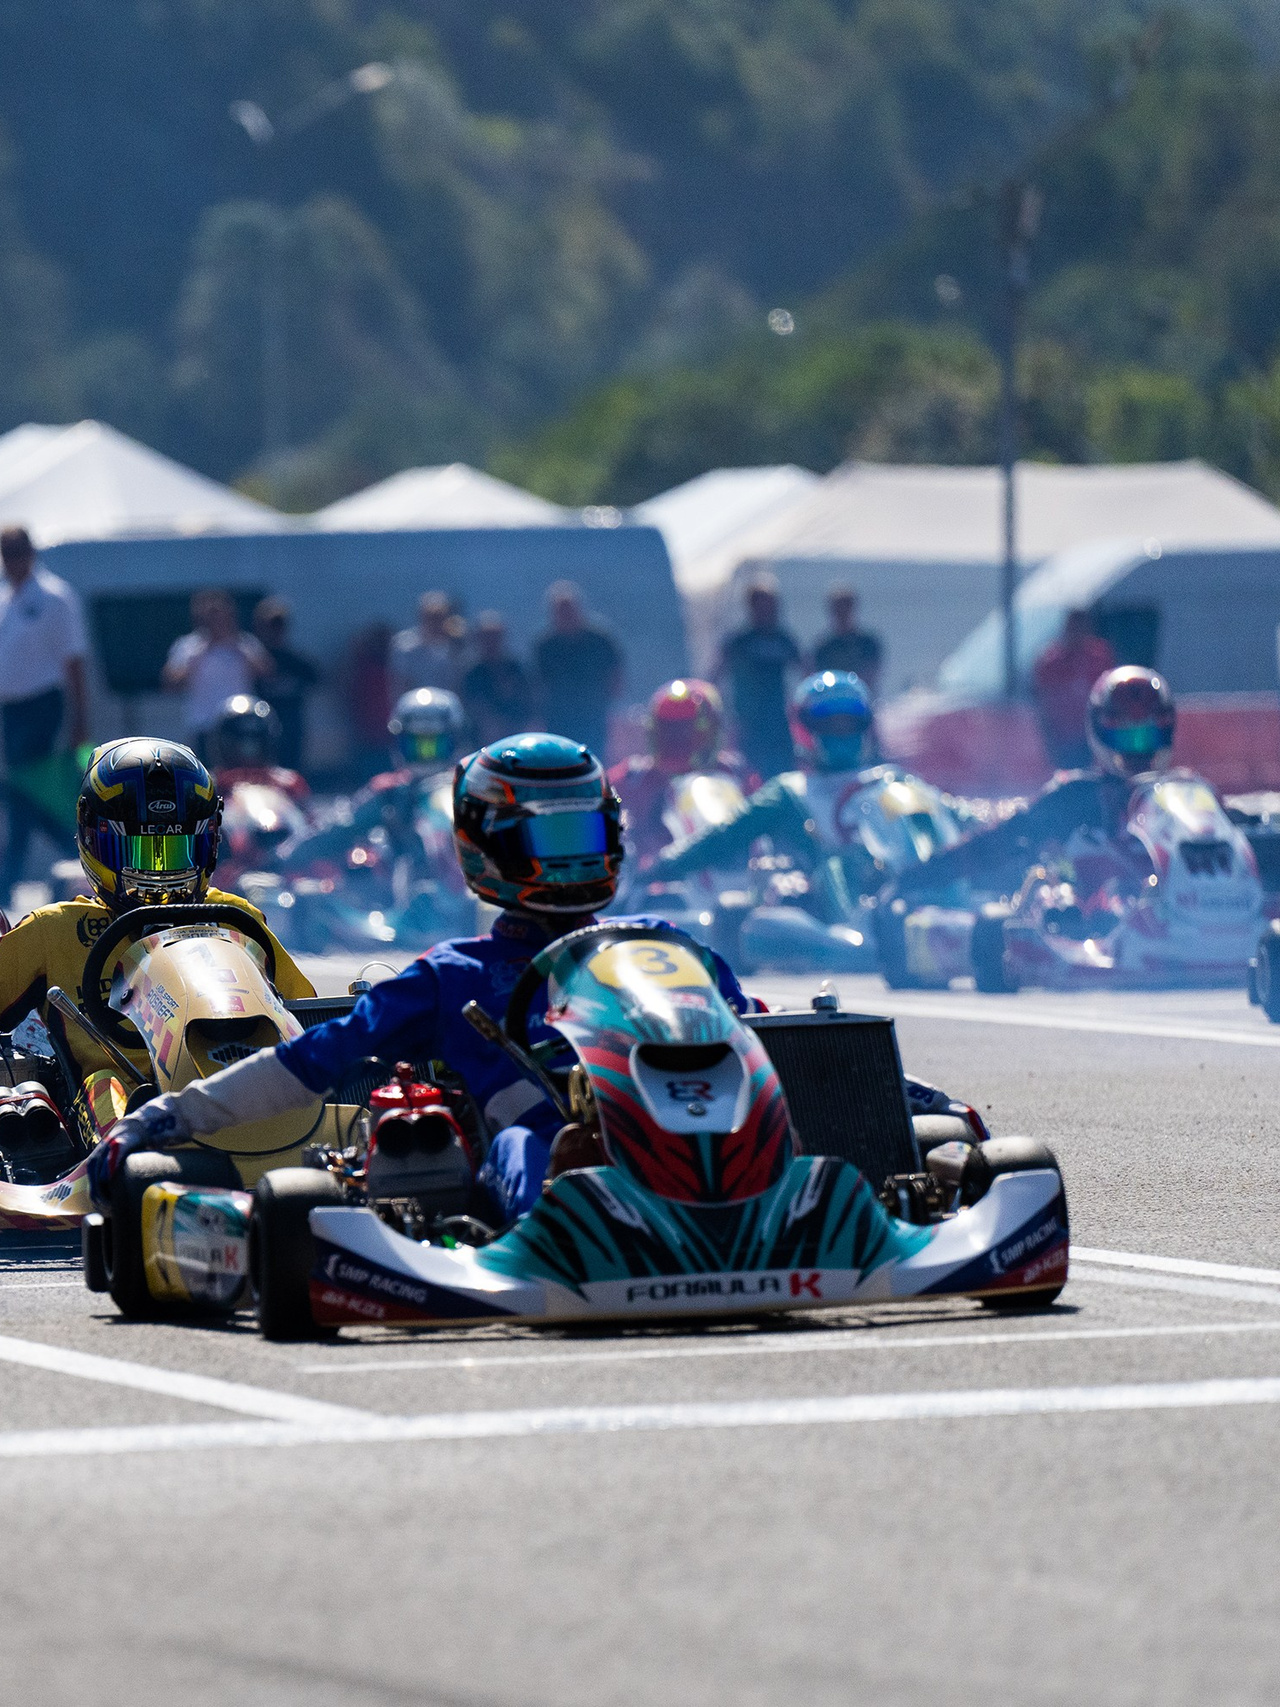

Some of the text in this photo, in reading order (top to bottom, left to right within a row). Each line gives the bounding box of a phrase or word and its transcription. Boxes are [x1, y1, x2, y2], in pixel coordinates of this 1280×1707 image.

[150, 801, 173, 810] Arai
[140, 824, 183, 835] LECAR
[630, 947, 679, 975] 3
[162, 992, 179, 1010] SPORT
[224, 1245, 240, 1271] K
[369, 1274, 427, 1303] RACING
[626, 1271, 823, 1303] FORMULA K
